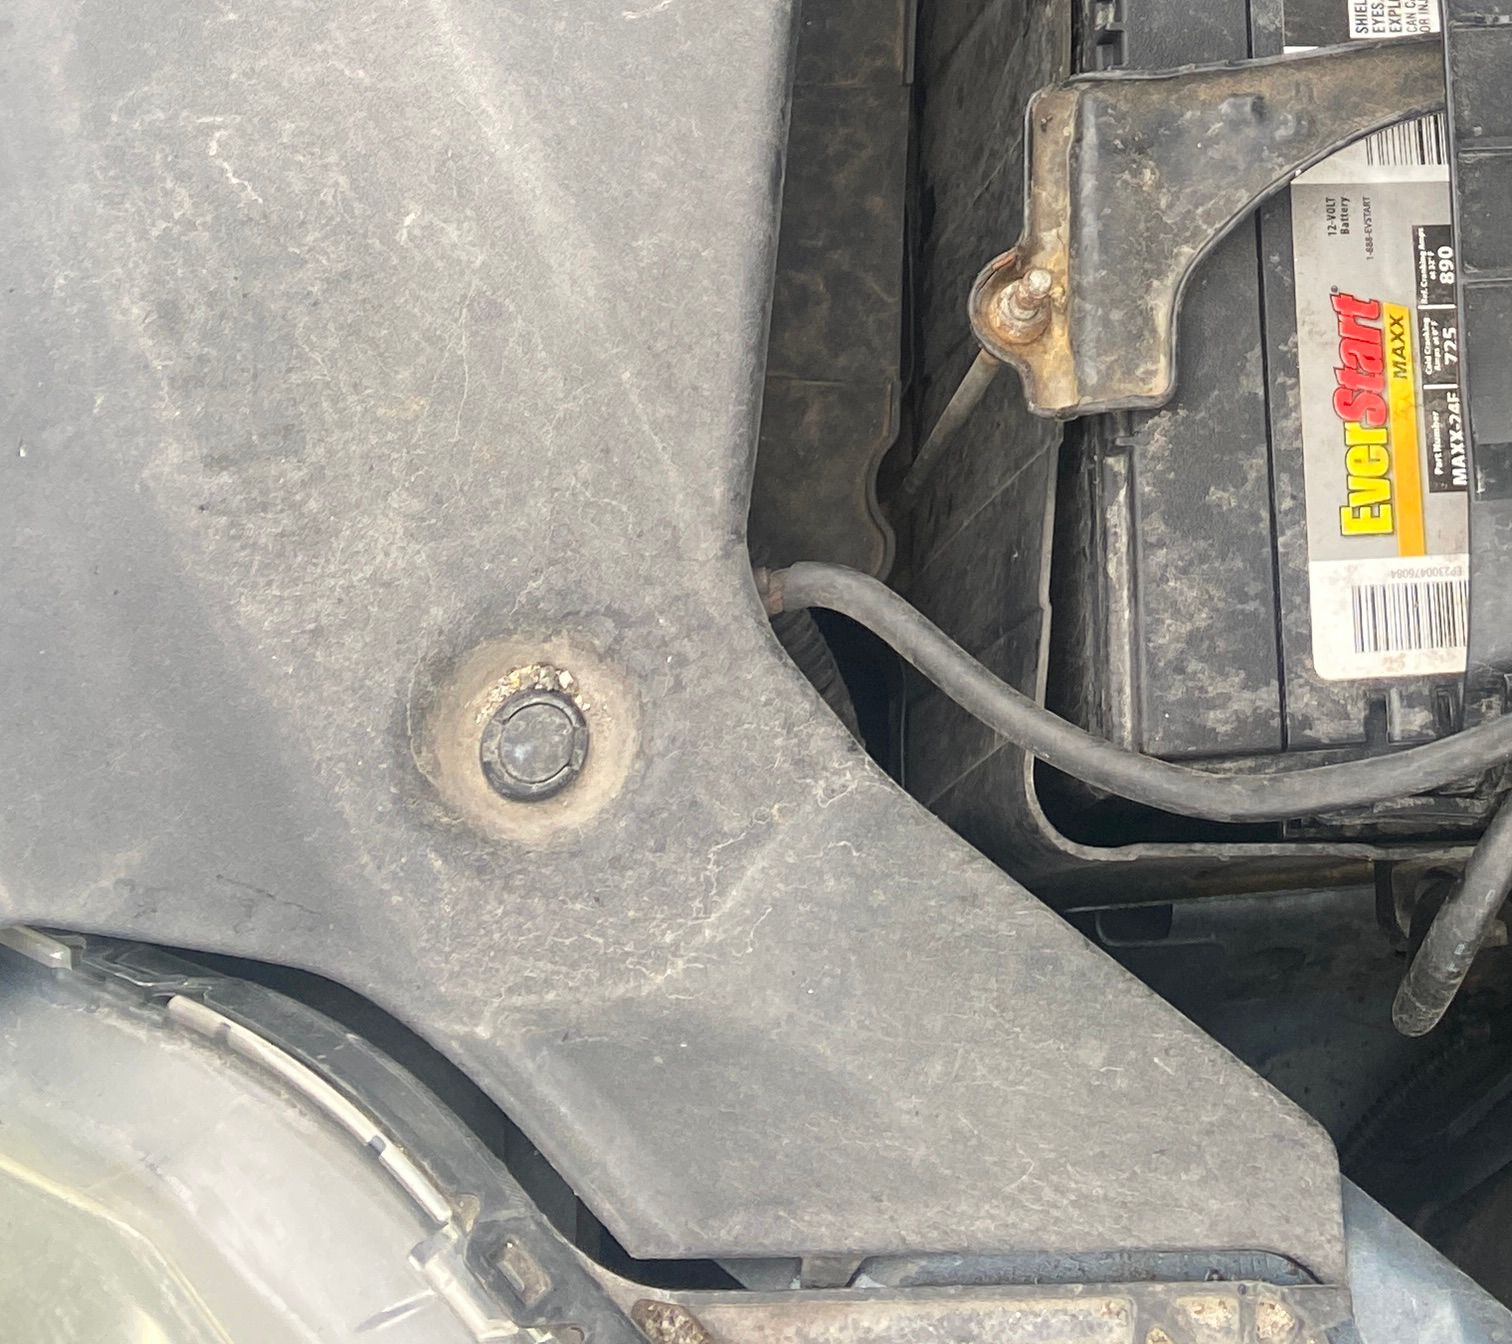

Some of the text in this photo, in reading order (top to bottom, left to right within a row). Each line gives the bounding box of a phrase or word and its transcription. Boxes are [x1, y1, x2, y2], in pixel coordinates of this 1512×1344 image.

[1405, 10, 1418, 33] CAN
[1419, 18, 1432, 33] OR
[1325, 196, 1338, 236] 12-VOLT
[1340, 196, 1351, 235] Battery
[1362, 196, 1375, 261] 1-888-EVSTART
[1437, 245, 1455, 285] 890
[1388, 313, 1408, 380] MAXX
[1441, 327, 1459, 366] 725
[1329, 292, 1395, 536] EverStart
[1431, 411, 1443, 476] Part Number
